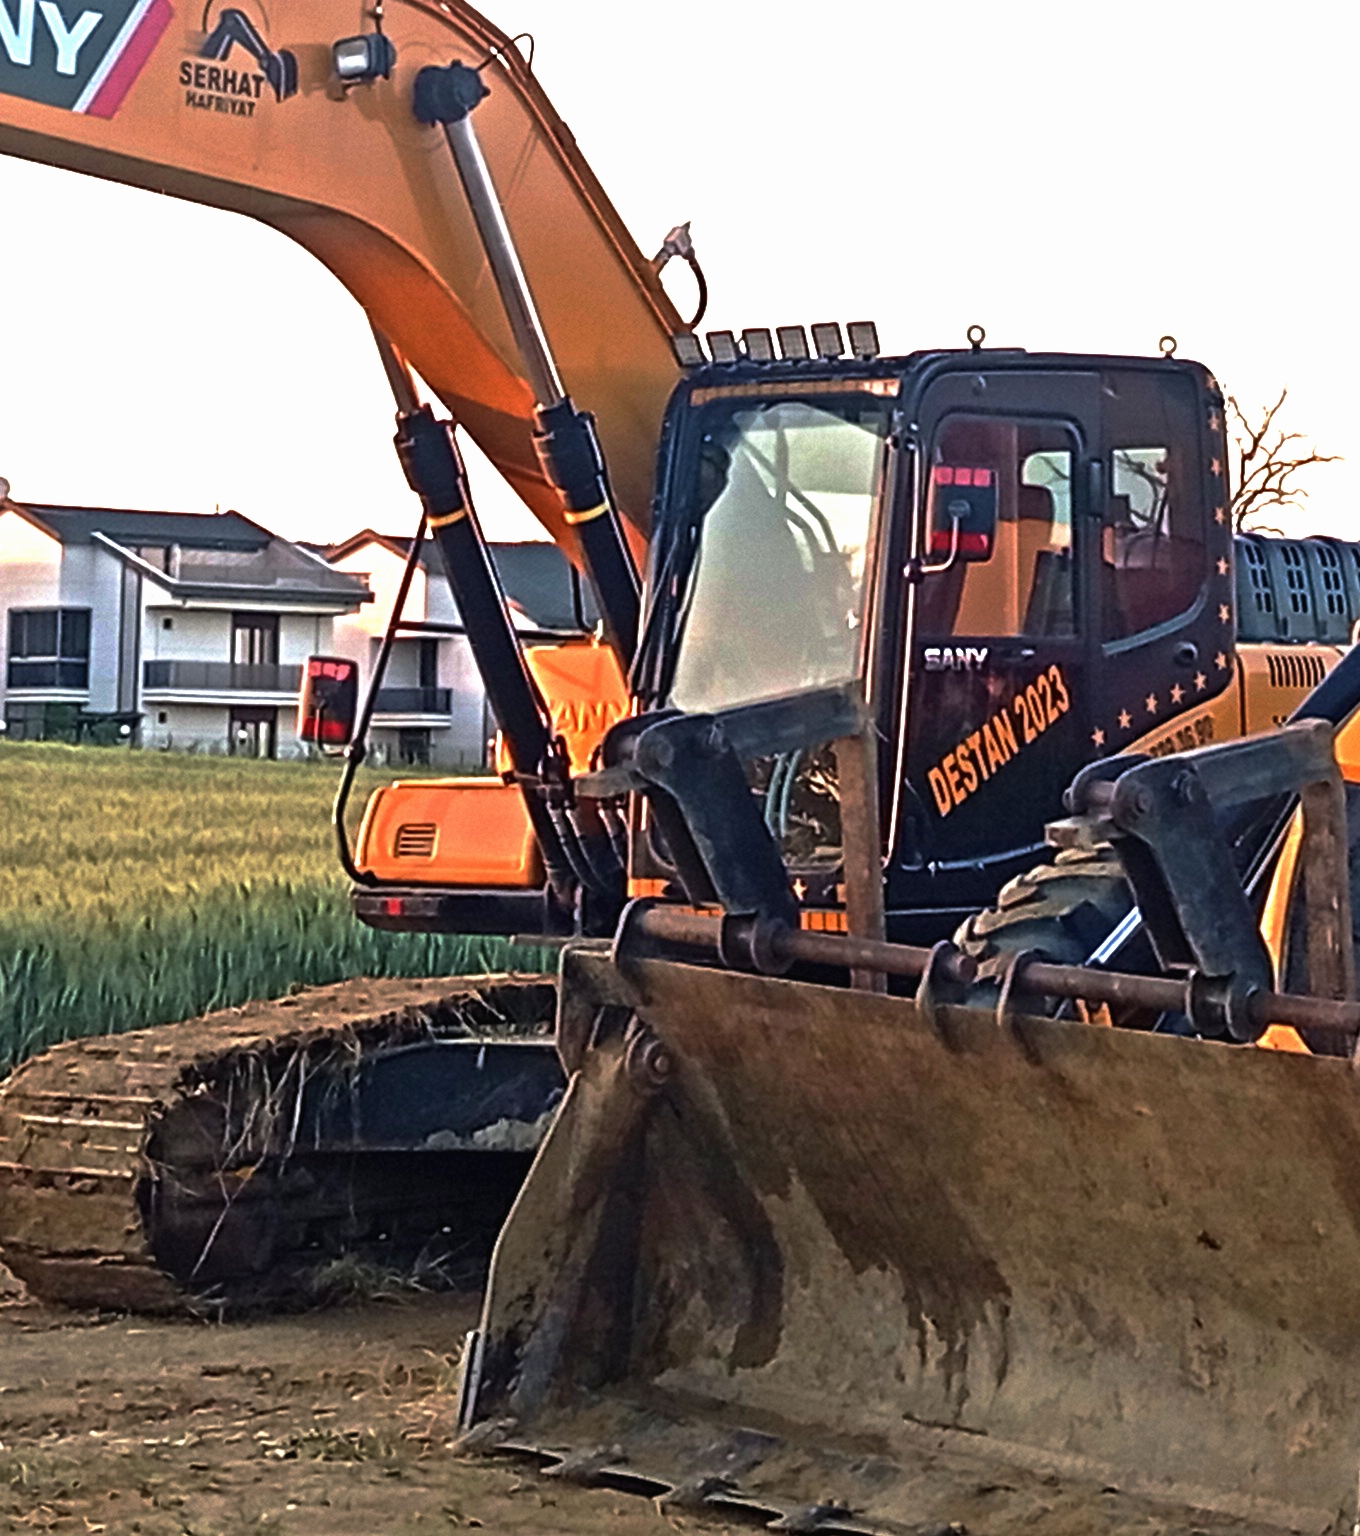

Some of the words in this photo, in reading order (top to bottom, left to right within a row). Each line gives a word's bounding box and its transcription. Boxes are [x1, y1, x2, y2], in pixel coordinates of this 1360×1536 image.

[179, 60, 264, 98] SERHAT
[924, 648, 988, 670] SANY
[927, 708, 1020, 817] DESTAN
[1014, 664, 1070, 744] 2023
